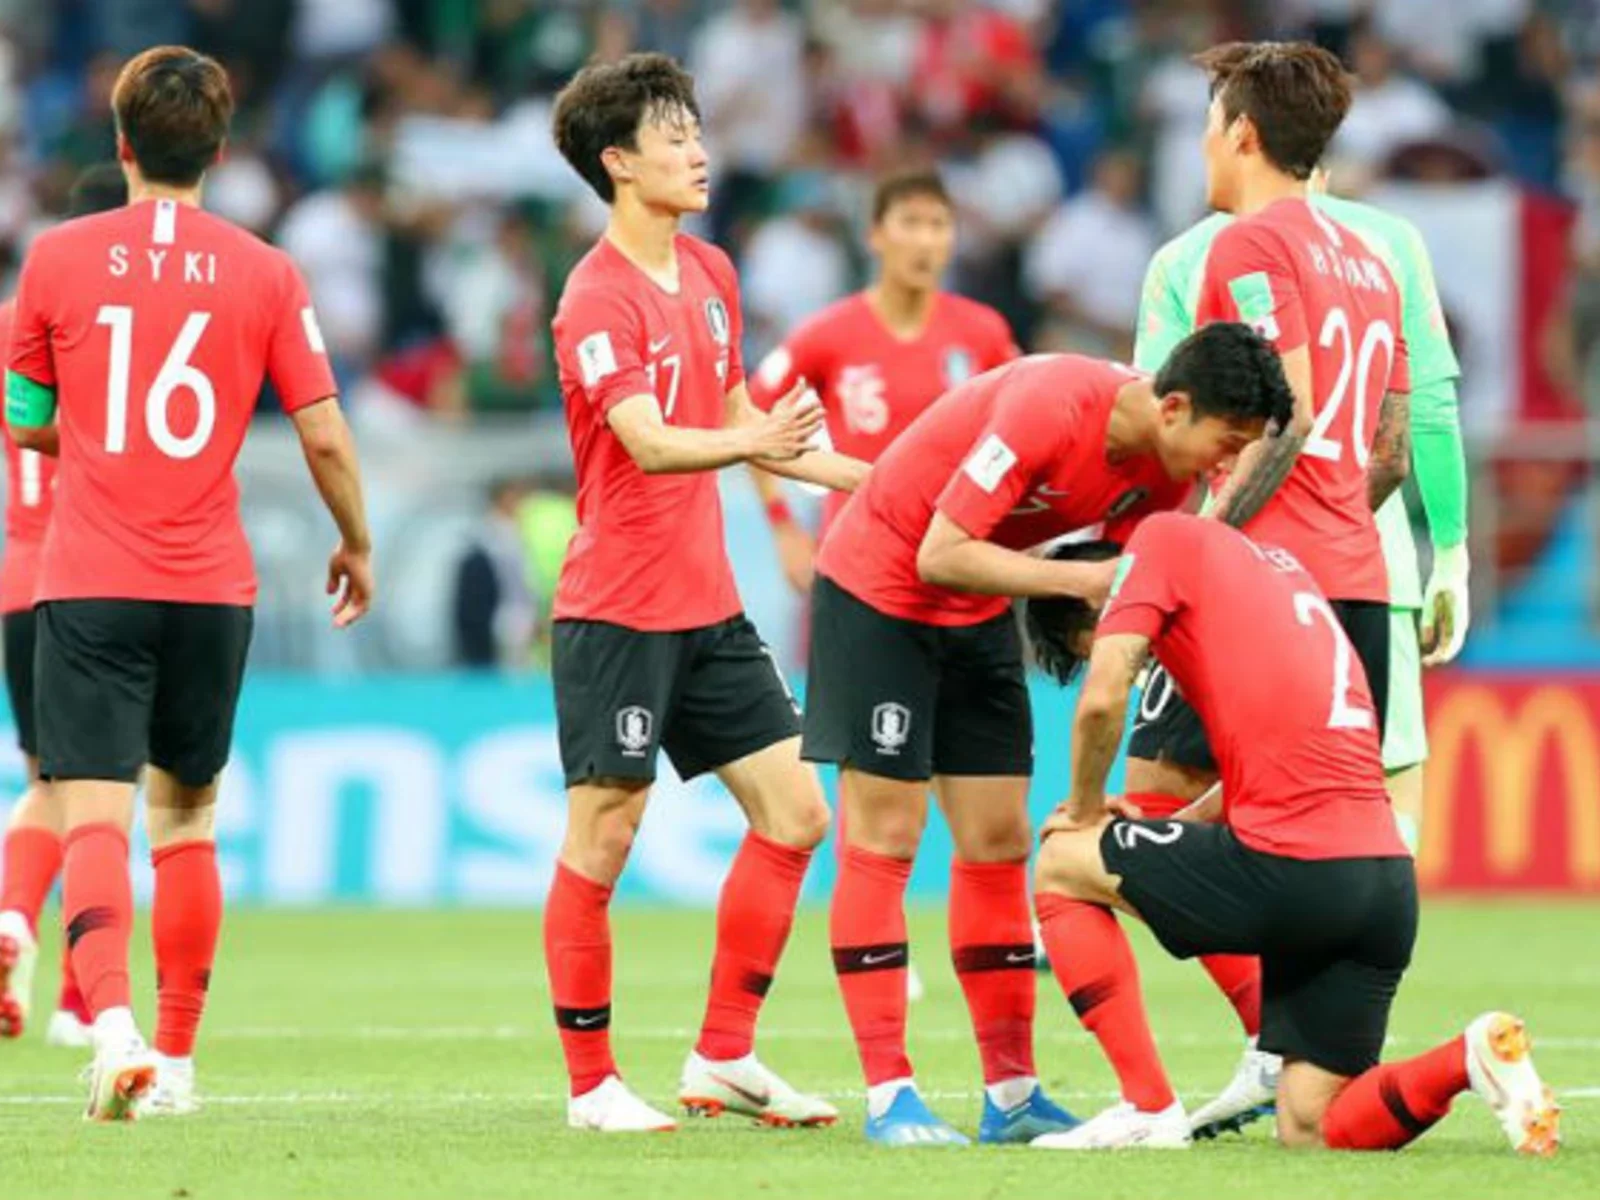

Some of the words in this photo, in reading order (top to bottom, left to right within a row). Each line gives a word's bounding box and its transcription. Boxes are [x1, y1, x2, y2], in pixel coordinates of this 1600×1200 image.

[183, 251, 216, 284] KI
[96, 305, 217, 460] 16
[1303, 306, 1395, 469] 20
[1293, 591, 1375, 730] 2
